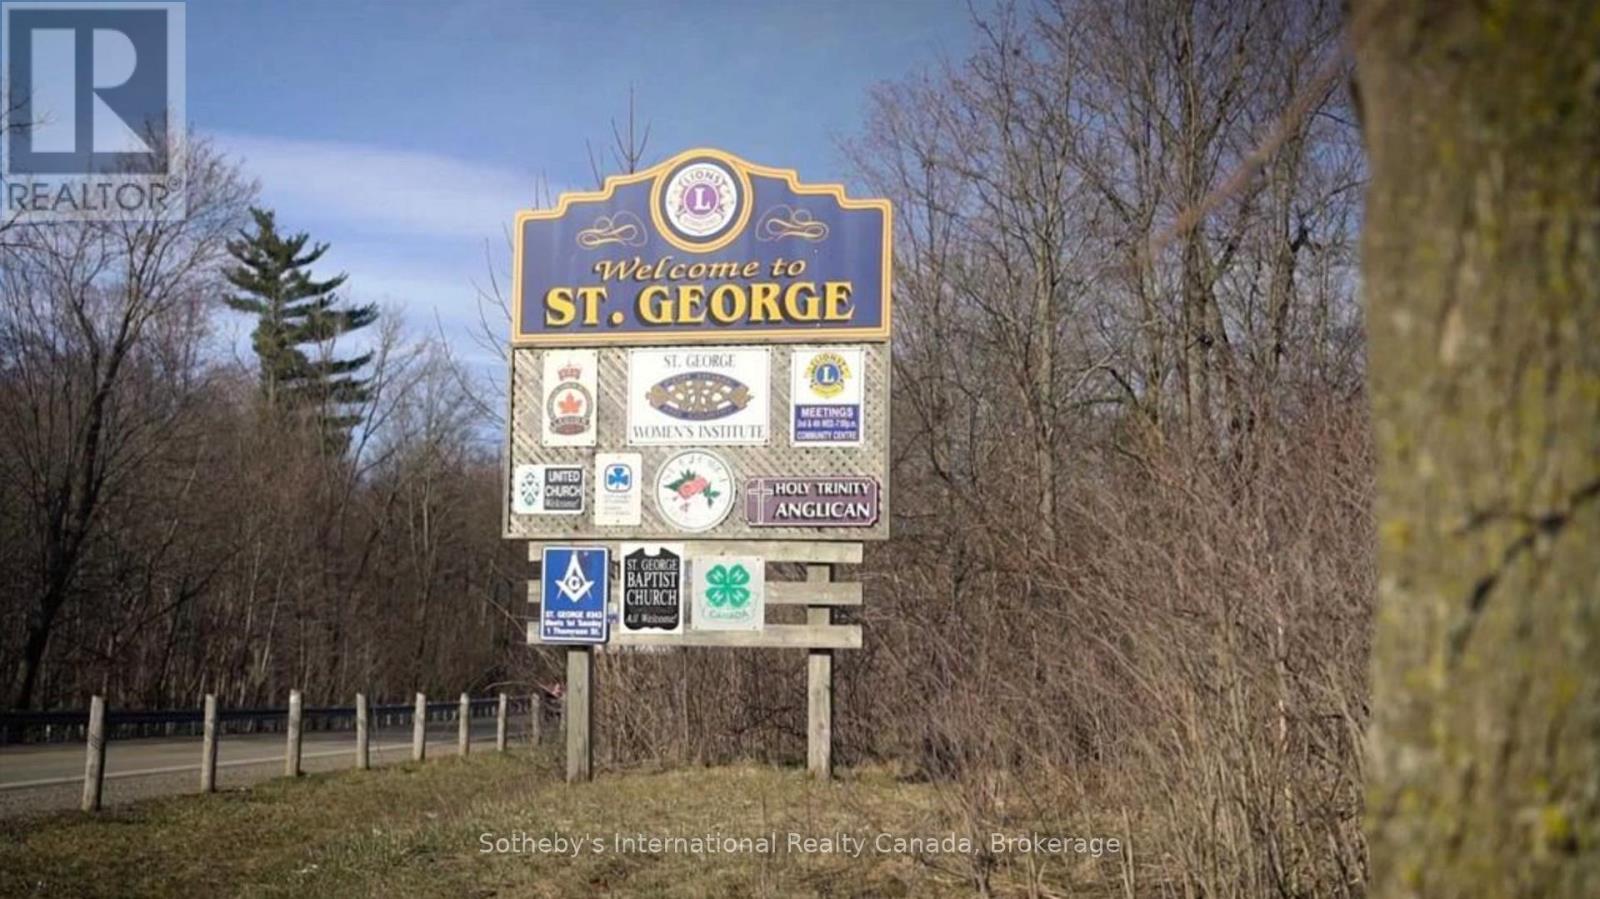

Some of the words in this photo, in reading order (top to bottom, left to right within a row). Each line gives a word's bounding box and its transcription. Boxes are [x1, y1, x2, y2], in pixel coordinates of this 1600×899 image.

[682, 169, 722, 184] LIONS
[693, 187, 711, 210] L
[594, 255, 761, 283] Welcome
[771, 257, 806, 278] to
[545, 286, 625, 326] ST.
[638, 281, 856, 326] GEORGE
[664, 354, 682, 368] ST.
[686, 353, 735, 368] GEORGE
[822, 366, 835, 384] L
[801, 407, 854, 418] MEETINGS
[633, 425, 695, 439] WOMEN'S
[699, 425, 766, 439] INSTITUTE
[797, 431, 831, 440] COMMUNITY
[833, 431, 857, 440] CENTRE
[548, 470, 580, 482] UNITED
[545, 484, 582, 497] CHURCH
[774, 482, 812, 495] HOLY
[817, 482, 870, 495] TRINITY
[774, 502, 870, 518] ANGLICAN
[641, 559, 678, 571] GEORGE
[627, 571, 677, 588] BAPTIST
[626, 589, 677, 606] CHURCH
